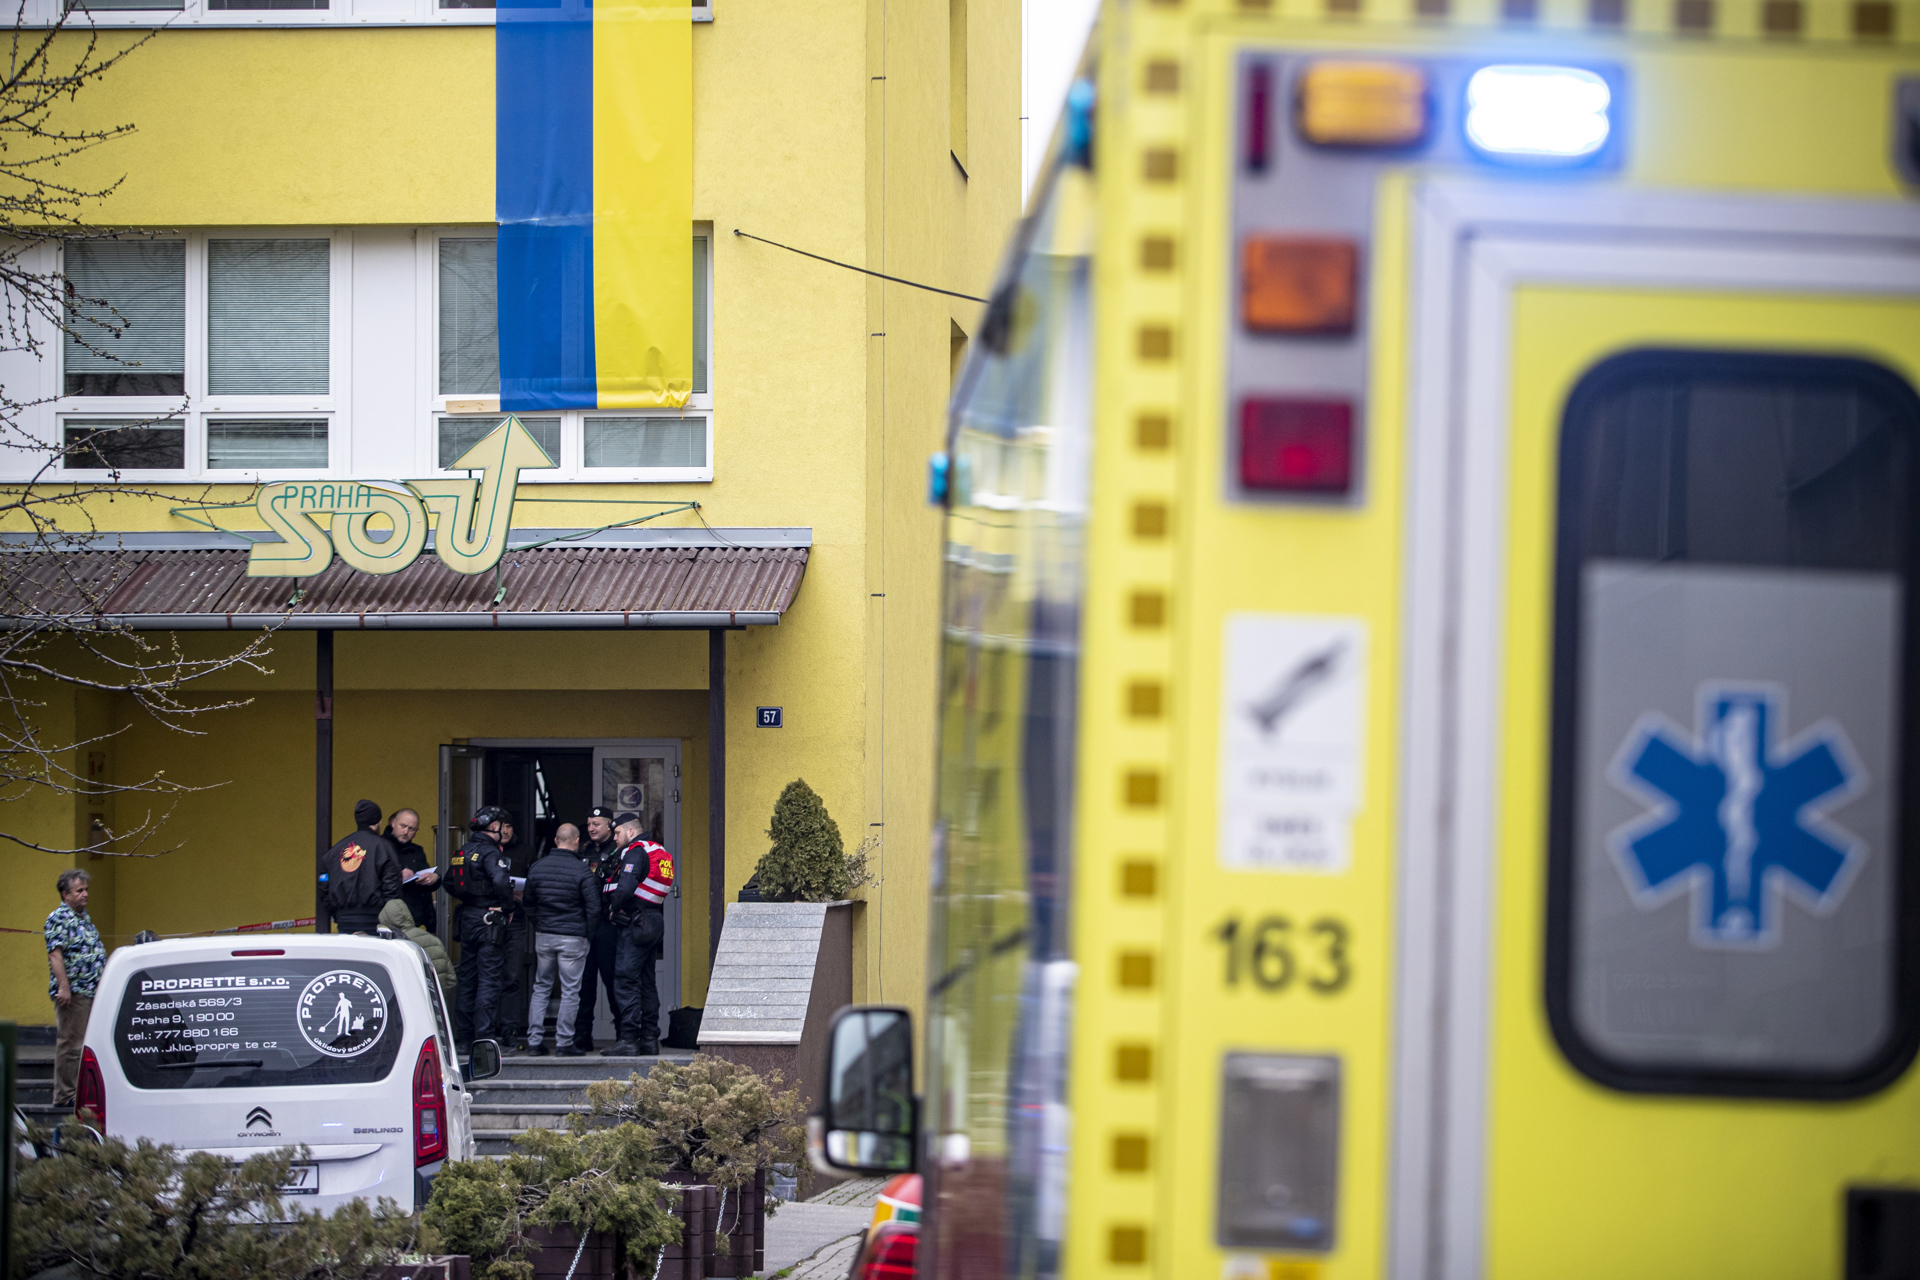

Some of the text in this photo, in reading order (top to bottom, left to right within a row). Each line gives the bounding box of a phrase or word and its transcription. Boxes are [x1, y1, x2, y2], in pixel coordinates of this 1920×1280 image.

[247, 413, 556, 577] SOU
[284, 484, 371, 509] PRAHA
[763, 710, 776, 723] 57
[1207, 911, 1351, 996] 163
[141, 976, 290, 991] PROPRETTE s.r.o.
[135, 997, 242, 1011] Zásadská 569/3
[301, 974, 383, 1019] PROPRETTE
[131, 1014, 170, 1026] Praha
[188, 1012, 214, 1023] 190
[216, 1012, 235, 1021] 00
[127, 1027, 239, 1041] tel.: 777 880 166
